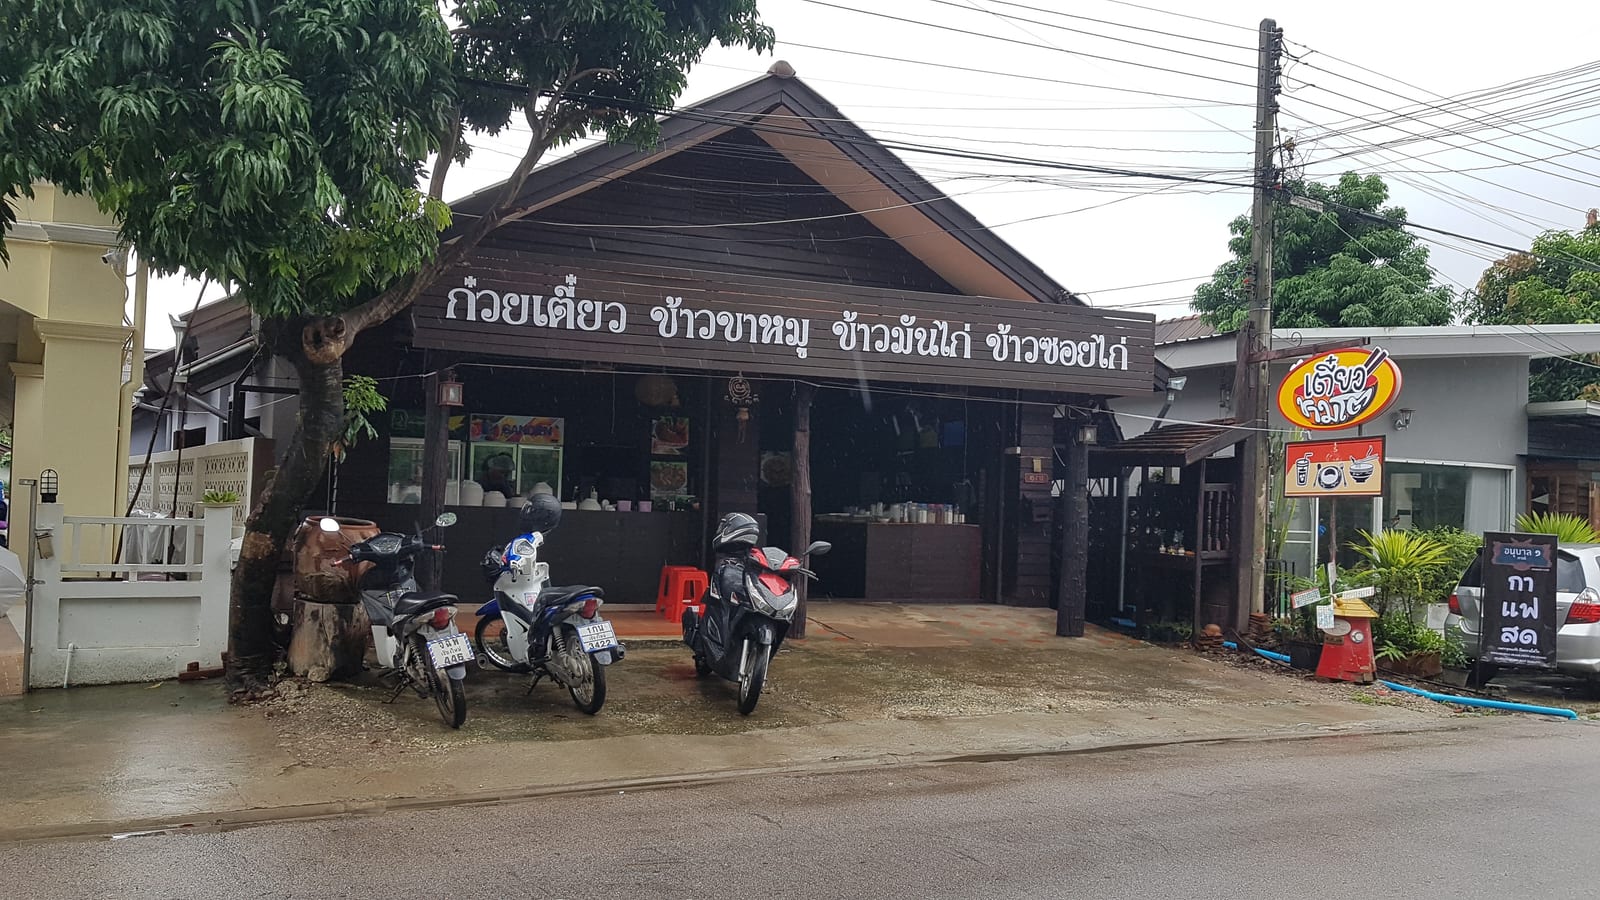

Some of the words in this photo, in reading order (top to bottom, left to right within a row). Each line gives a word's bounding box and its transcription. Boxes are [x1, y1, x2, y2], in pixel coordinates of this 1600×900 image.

[445, 273, 627, 334] ก๋วยเตี๋ยว
[650, 296, 810, 359] ข้าวขาหมู
[832, 310, 971, 359] ข้าวมันไก่
[986, 323, 1128, 370] ข้าวซอยไก่
[1305, 355, 1366, 397] เตี๋ยว
[1504, 547, 1532, 558] อนุบาล
[1508, 575, 1534, 593] กา
[1502, 597, 1539, 619] แฟ
[588, 639, 611, 650] 3422
[1501, 626, 1538, 645] สด
[444, 653, 464, 664] 446
